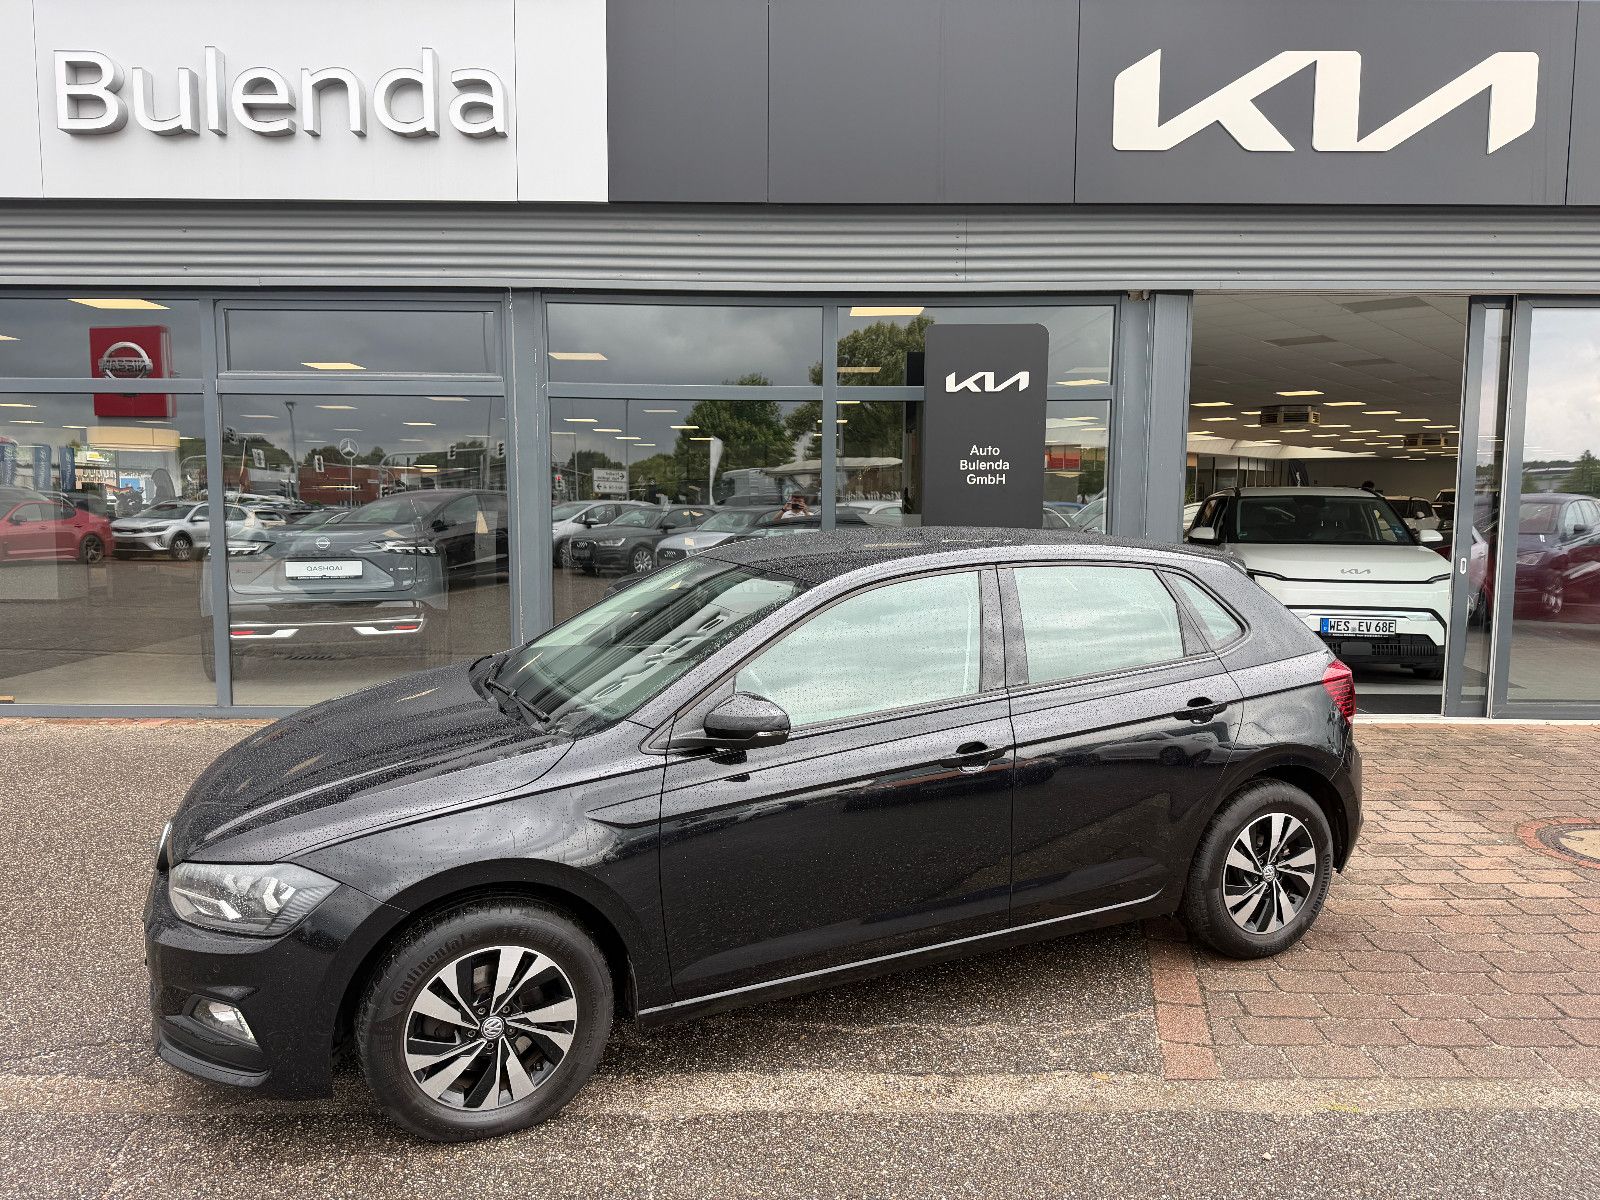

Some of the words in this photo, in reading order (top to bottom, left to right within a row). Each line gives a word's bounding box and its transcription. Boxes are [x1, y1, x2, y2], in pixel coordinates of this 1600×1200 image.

[53, 46, 508, 137] Bulenda
[969, 445, 1000, 456] Auto
[960, 459, 1010, 471] Bulenda
[966, 474, 1006, 485] GmbH
[1329, 620, 1350, 632] WES
[1358, 621, 1372, 633] EV
[1374, 621, 1395, 633] 68E
